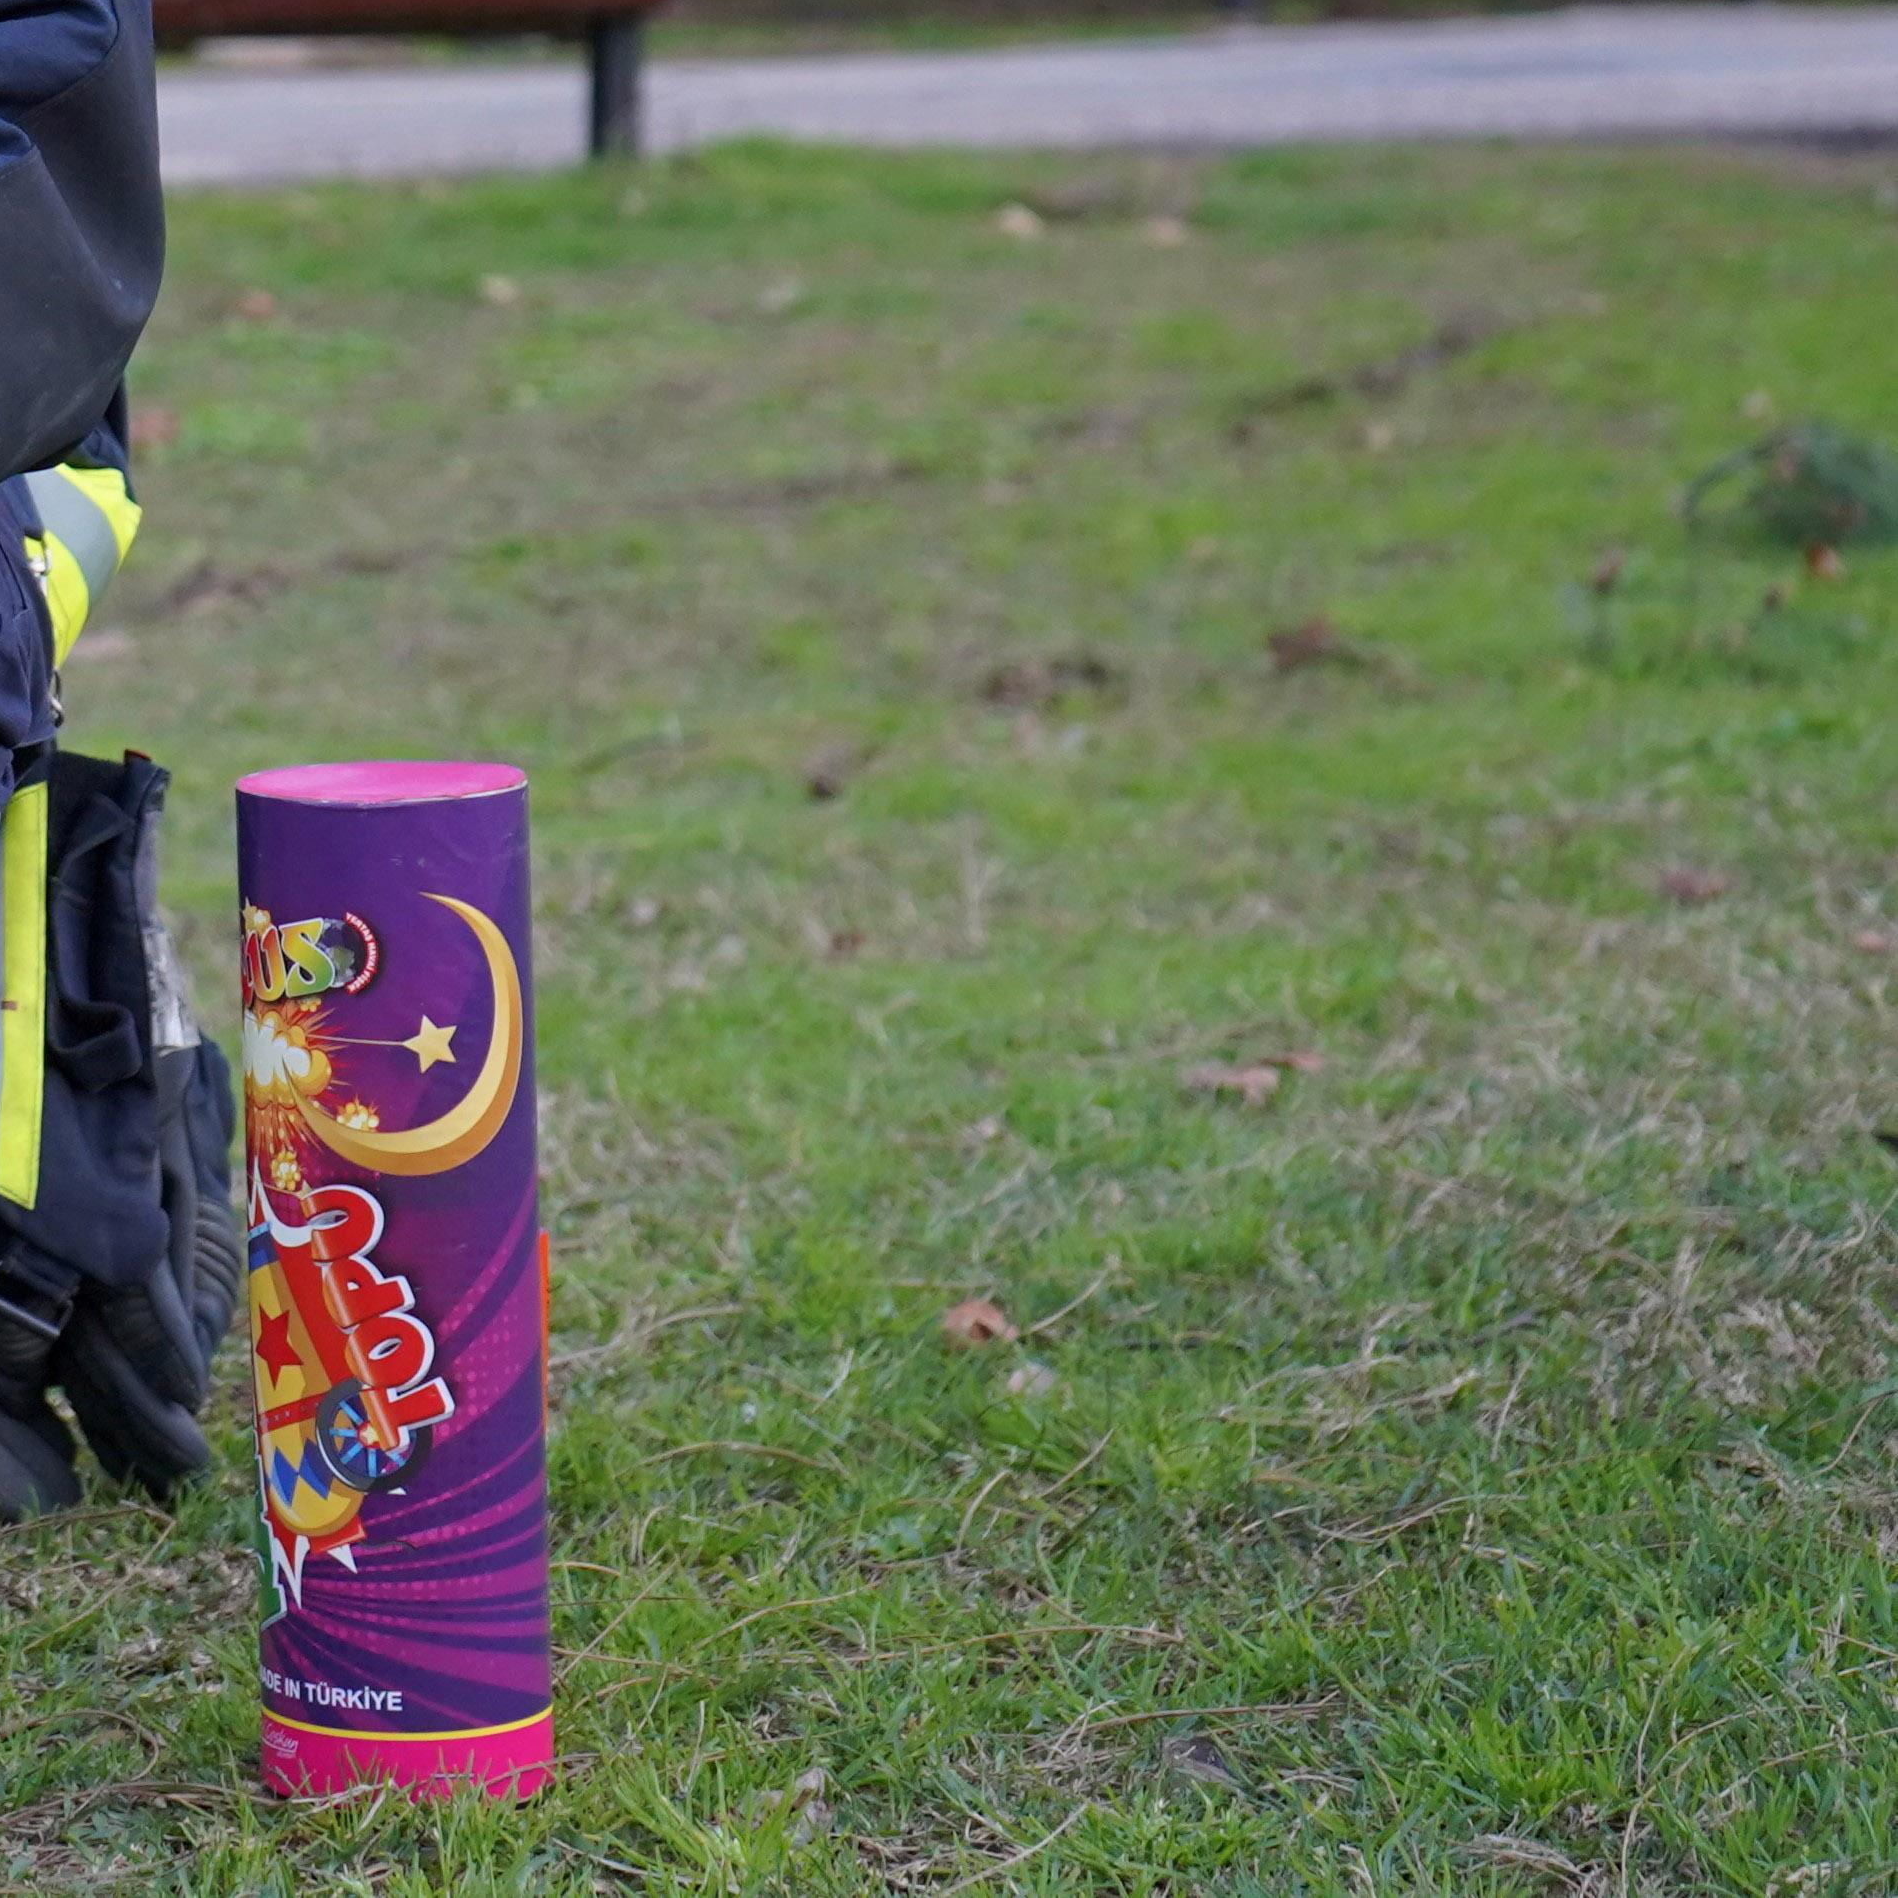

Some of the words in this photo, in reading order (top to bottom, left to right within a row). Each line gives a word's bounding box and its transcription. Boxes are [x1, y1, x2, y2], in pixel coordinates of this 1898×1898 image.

[300, 1184, 455, 1453] TOPU
[284, 1677, 301, 1700] IN
[304, 1682, 403, 1711] TÜRKİYE
